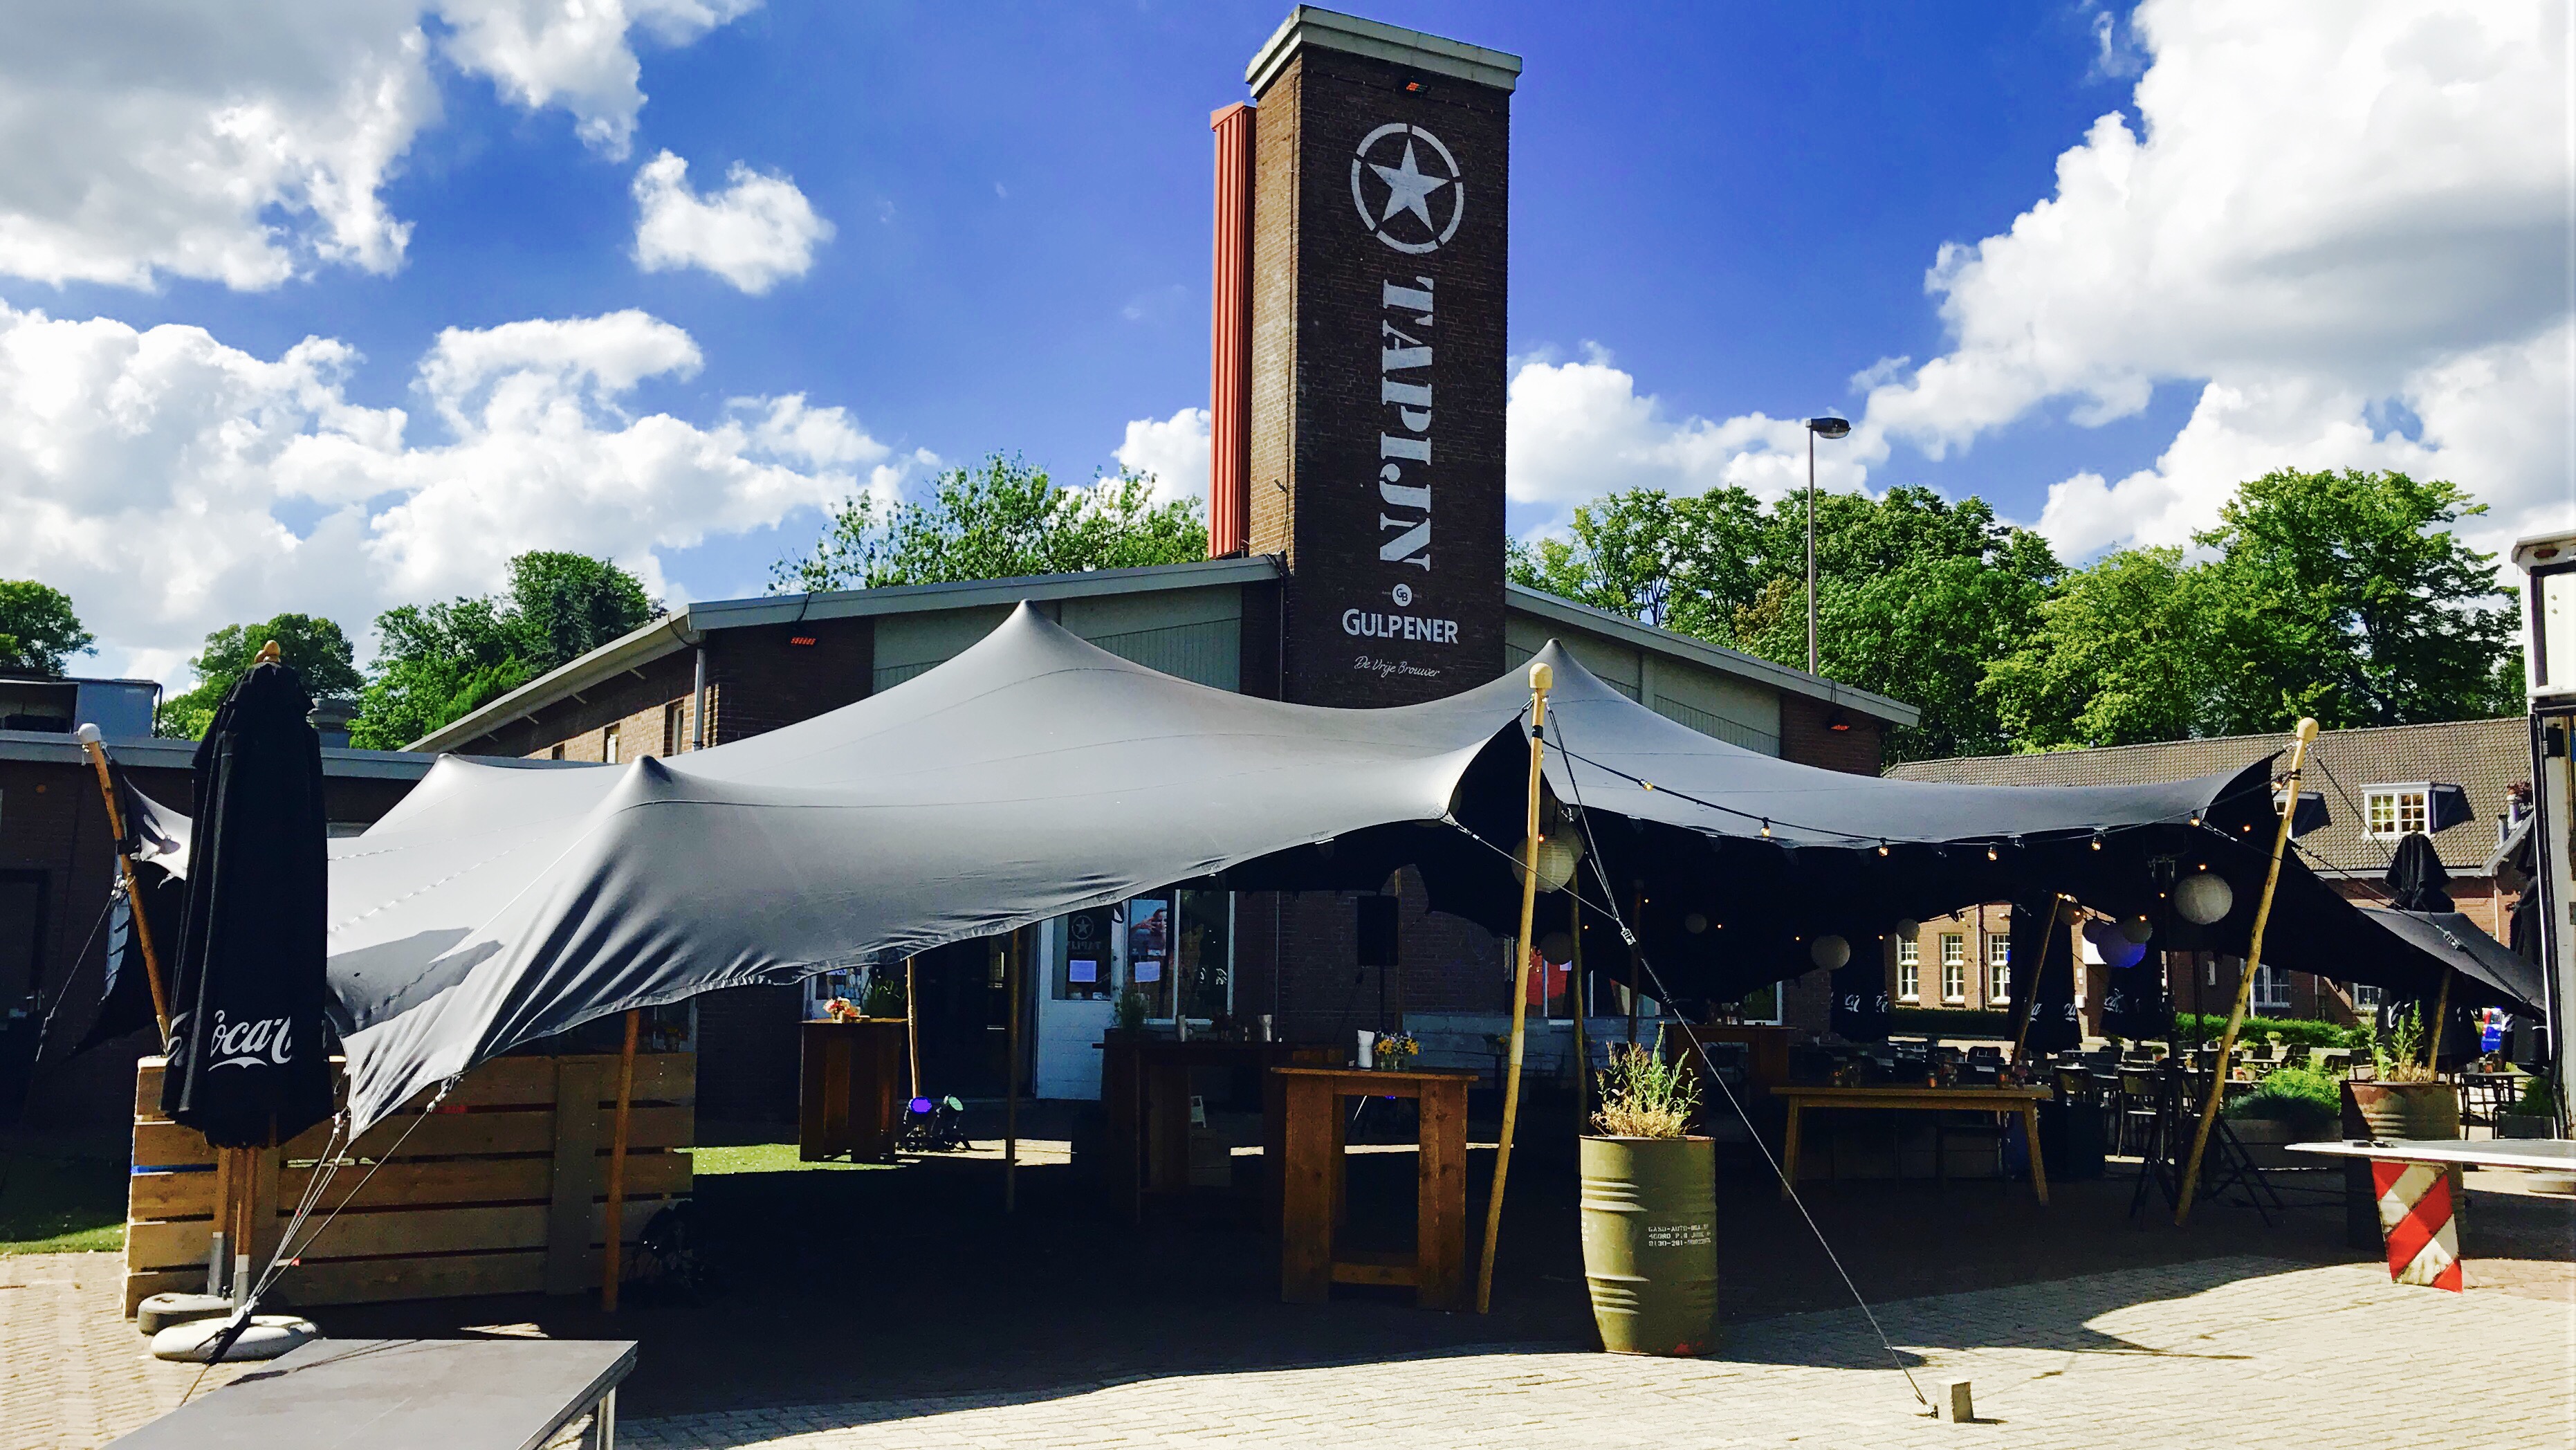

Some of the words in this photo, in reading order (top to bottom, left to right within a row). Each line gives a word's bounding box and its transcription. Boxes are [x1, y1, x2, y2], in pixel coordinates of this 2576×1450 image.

[1379, 275, 1433, 571] TAPIJN
[1342, 608, 1459, 644] GULPENER
[1354, 655, 1370, 670] De
[1372, 659, 1397, 678] Vrije
[1397, 661, 1441, 677] Brouwer
